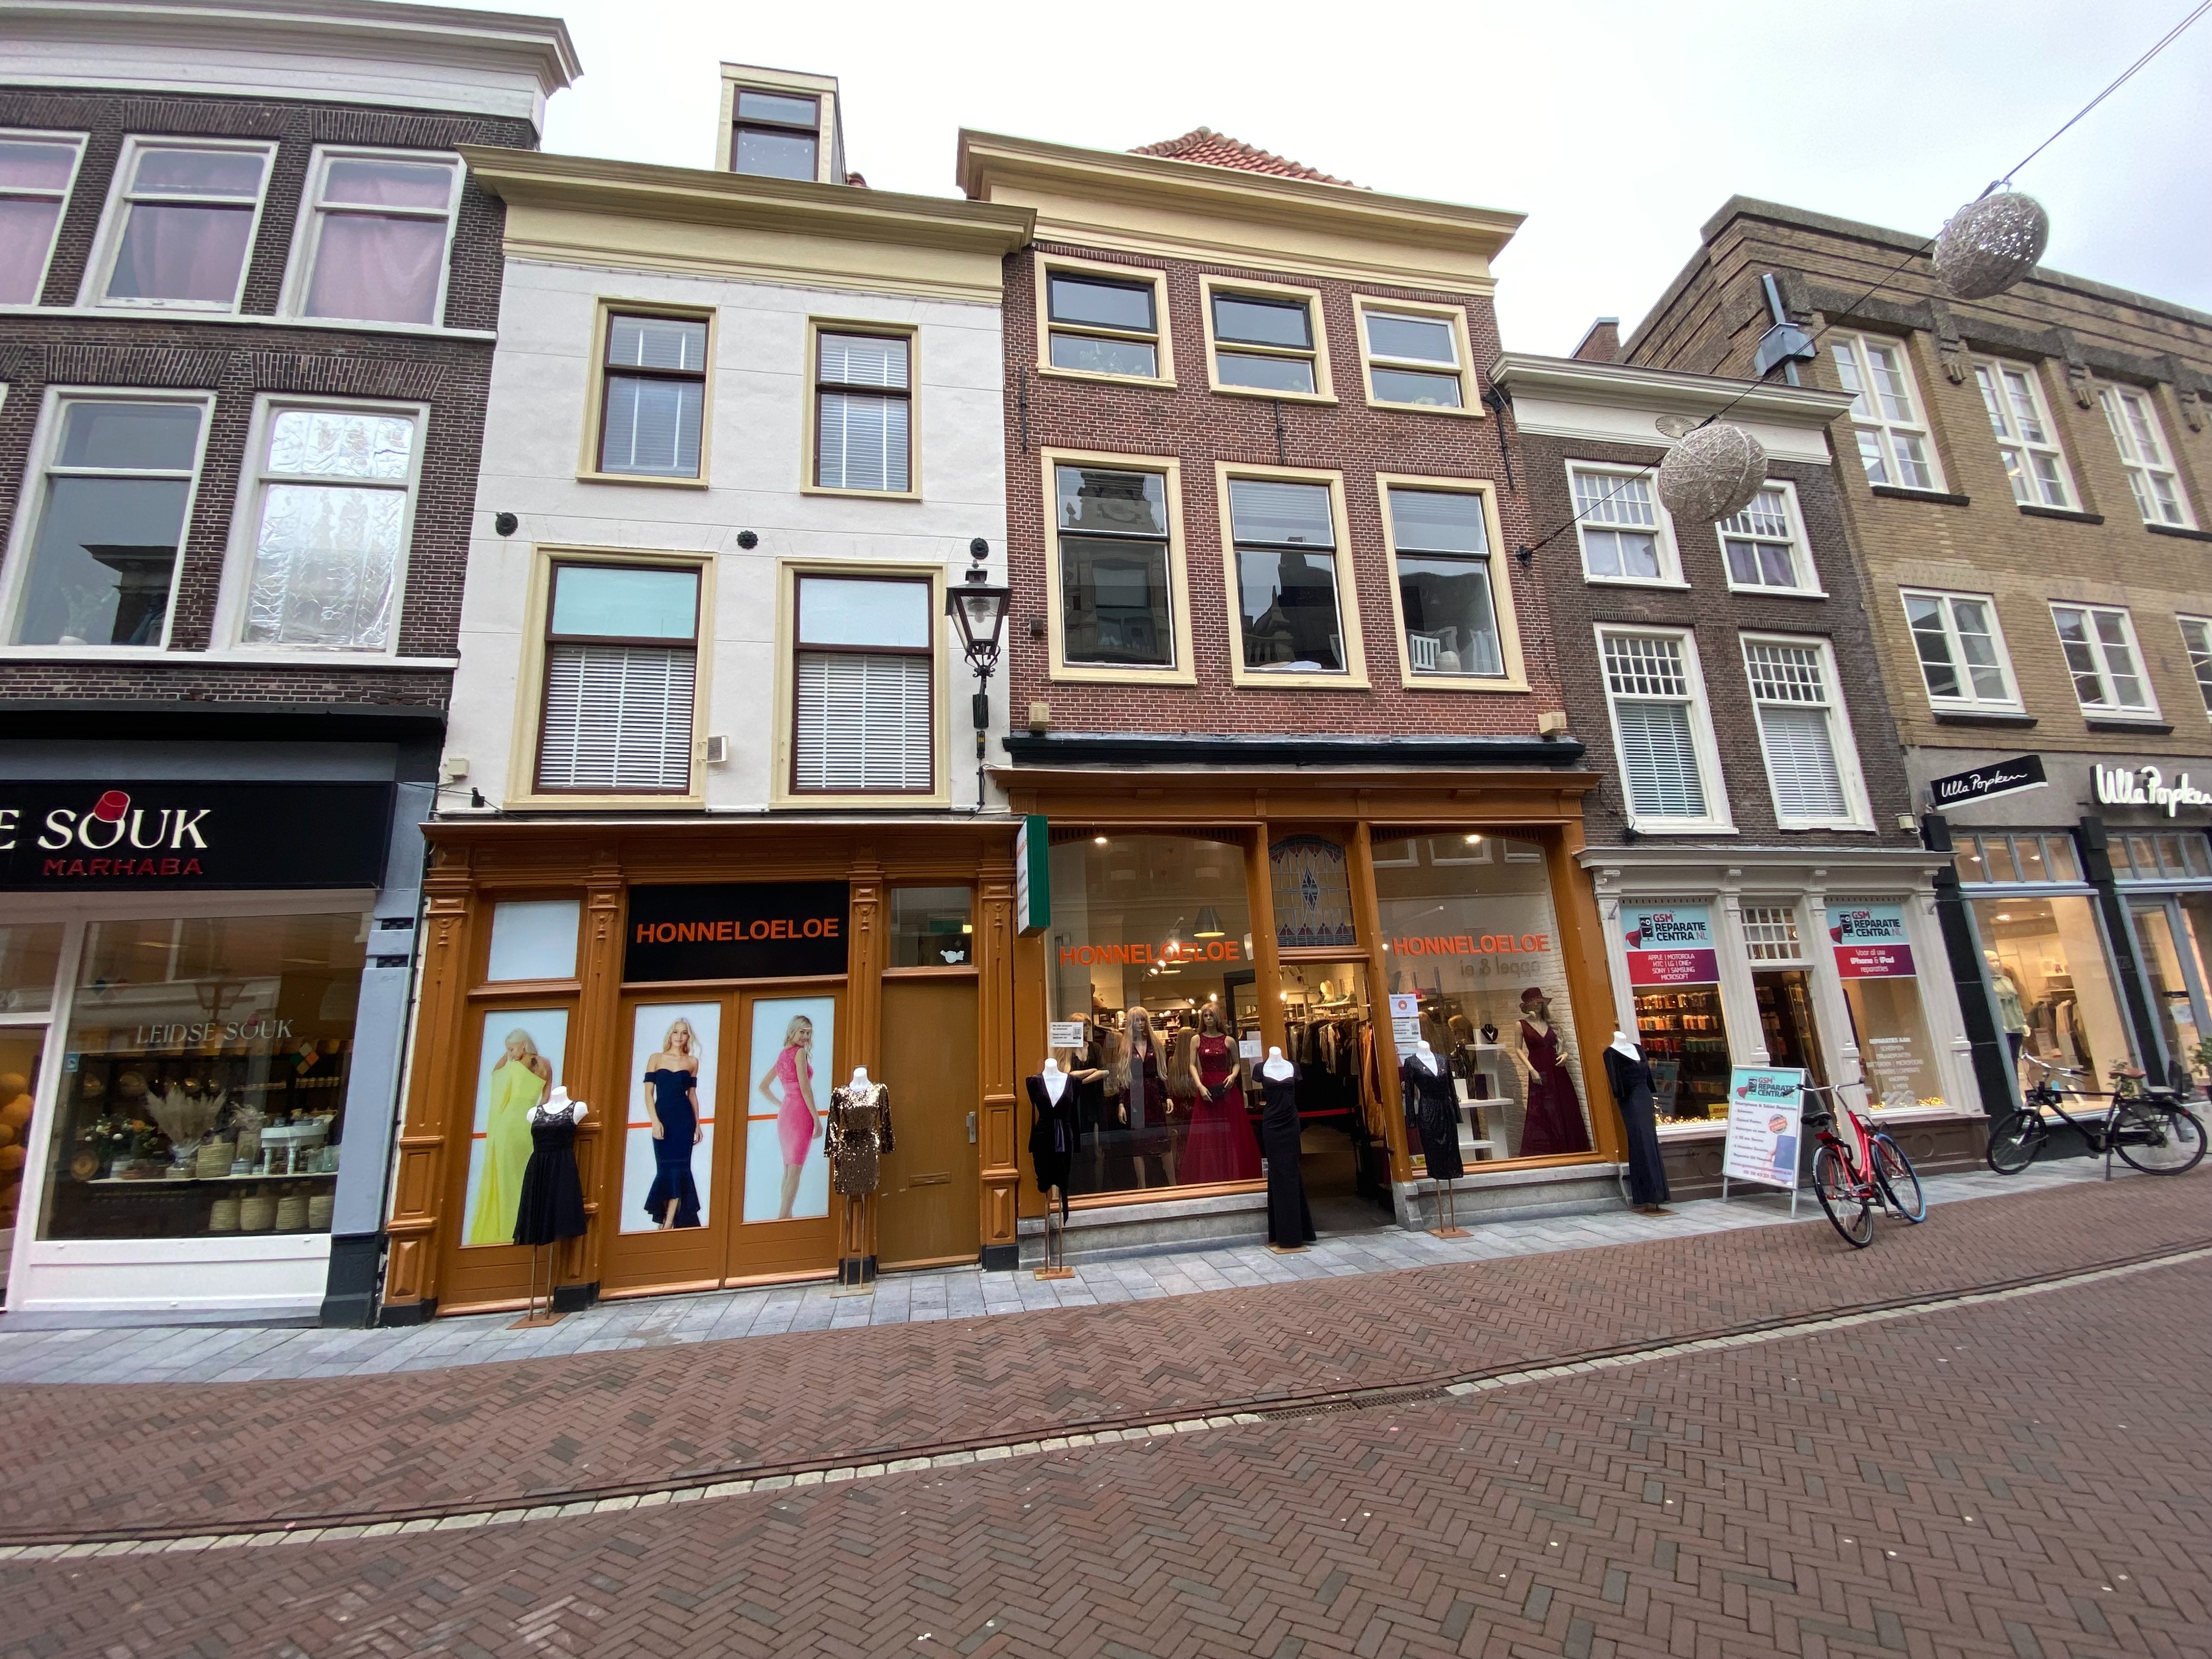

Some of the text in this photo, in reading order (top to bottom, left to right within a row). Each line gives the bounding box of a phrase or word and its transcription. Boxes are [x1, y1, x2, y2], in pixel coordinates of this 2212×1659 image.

[1941, 770, 2028, 798] Ulla Popken
[2096, 764, 2148, 804] Ulla
[37, 809, 211, 849] SOUK
[43, 858, 204, 876] MARHABA
[1652, 913, 1673, 923] GSM
[1852, 911, 1870, 919] GSM
[1854, 919, 1901, 928] REPARATIE
[636, 918, 839, 944] HONNELOELOE
[1655, 922, 1707, 932] REPARATIE
[1656, 932, 1708, 941] CENTRA.NL
[1060, 941, 1240, 966] HONNELOELOE
[1392, 934, 1551, 956] HONNELOELOE
[137, 1019, 295, 1043] LEIDSE SOUK
[1758, 1084, 1796, 1092] REPARAT
